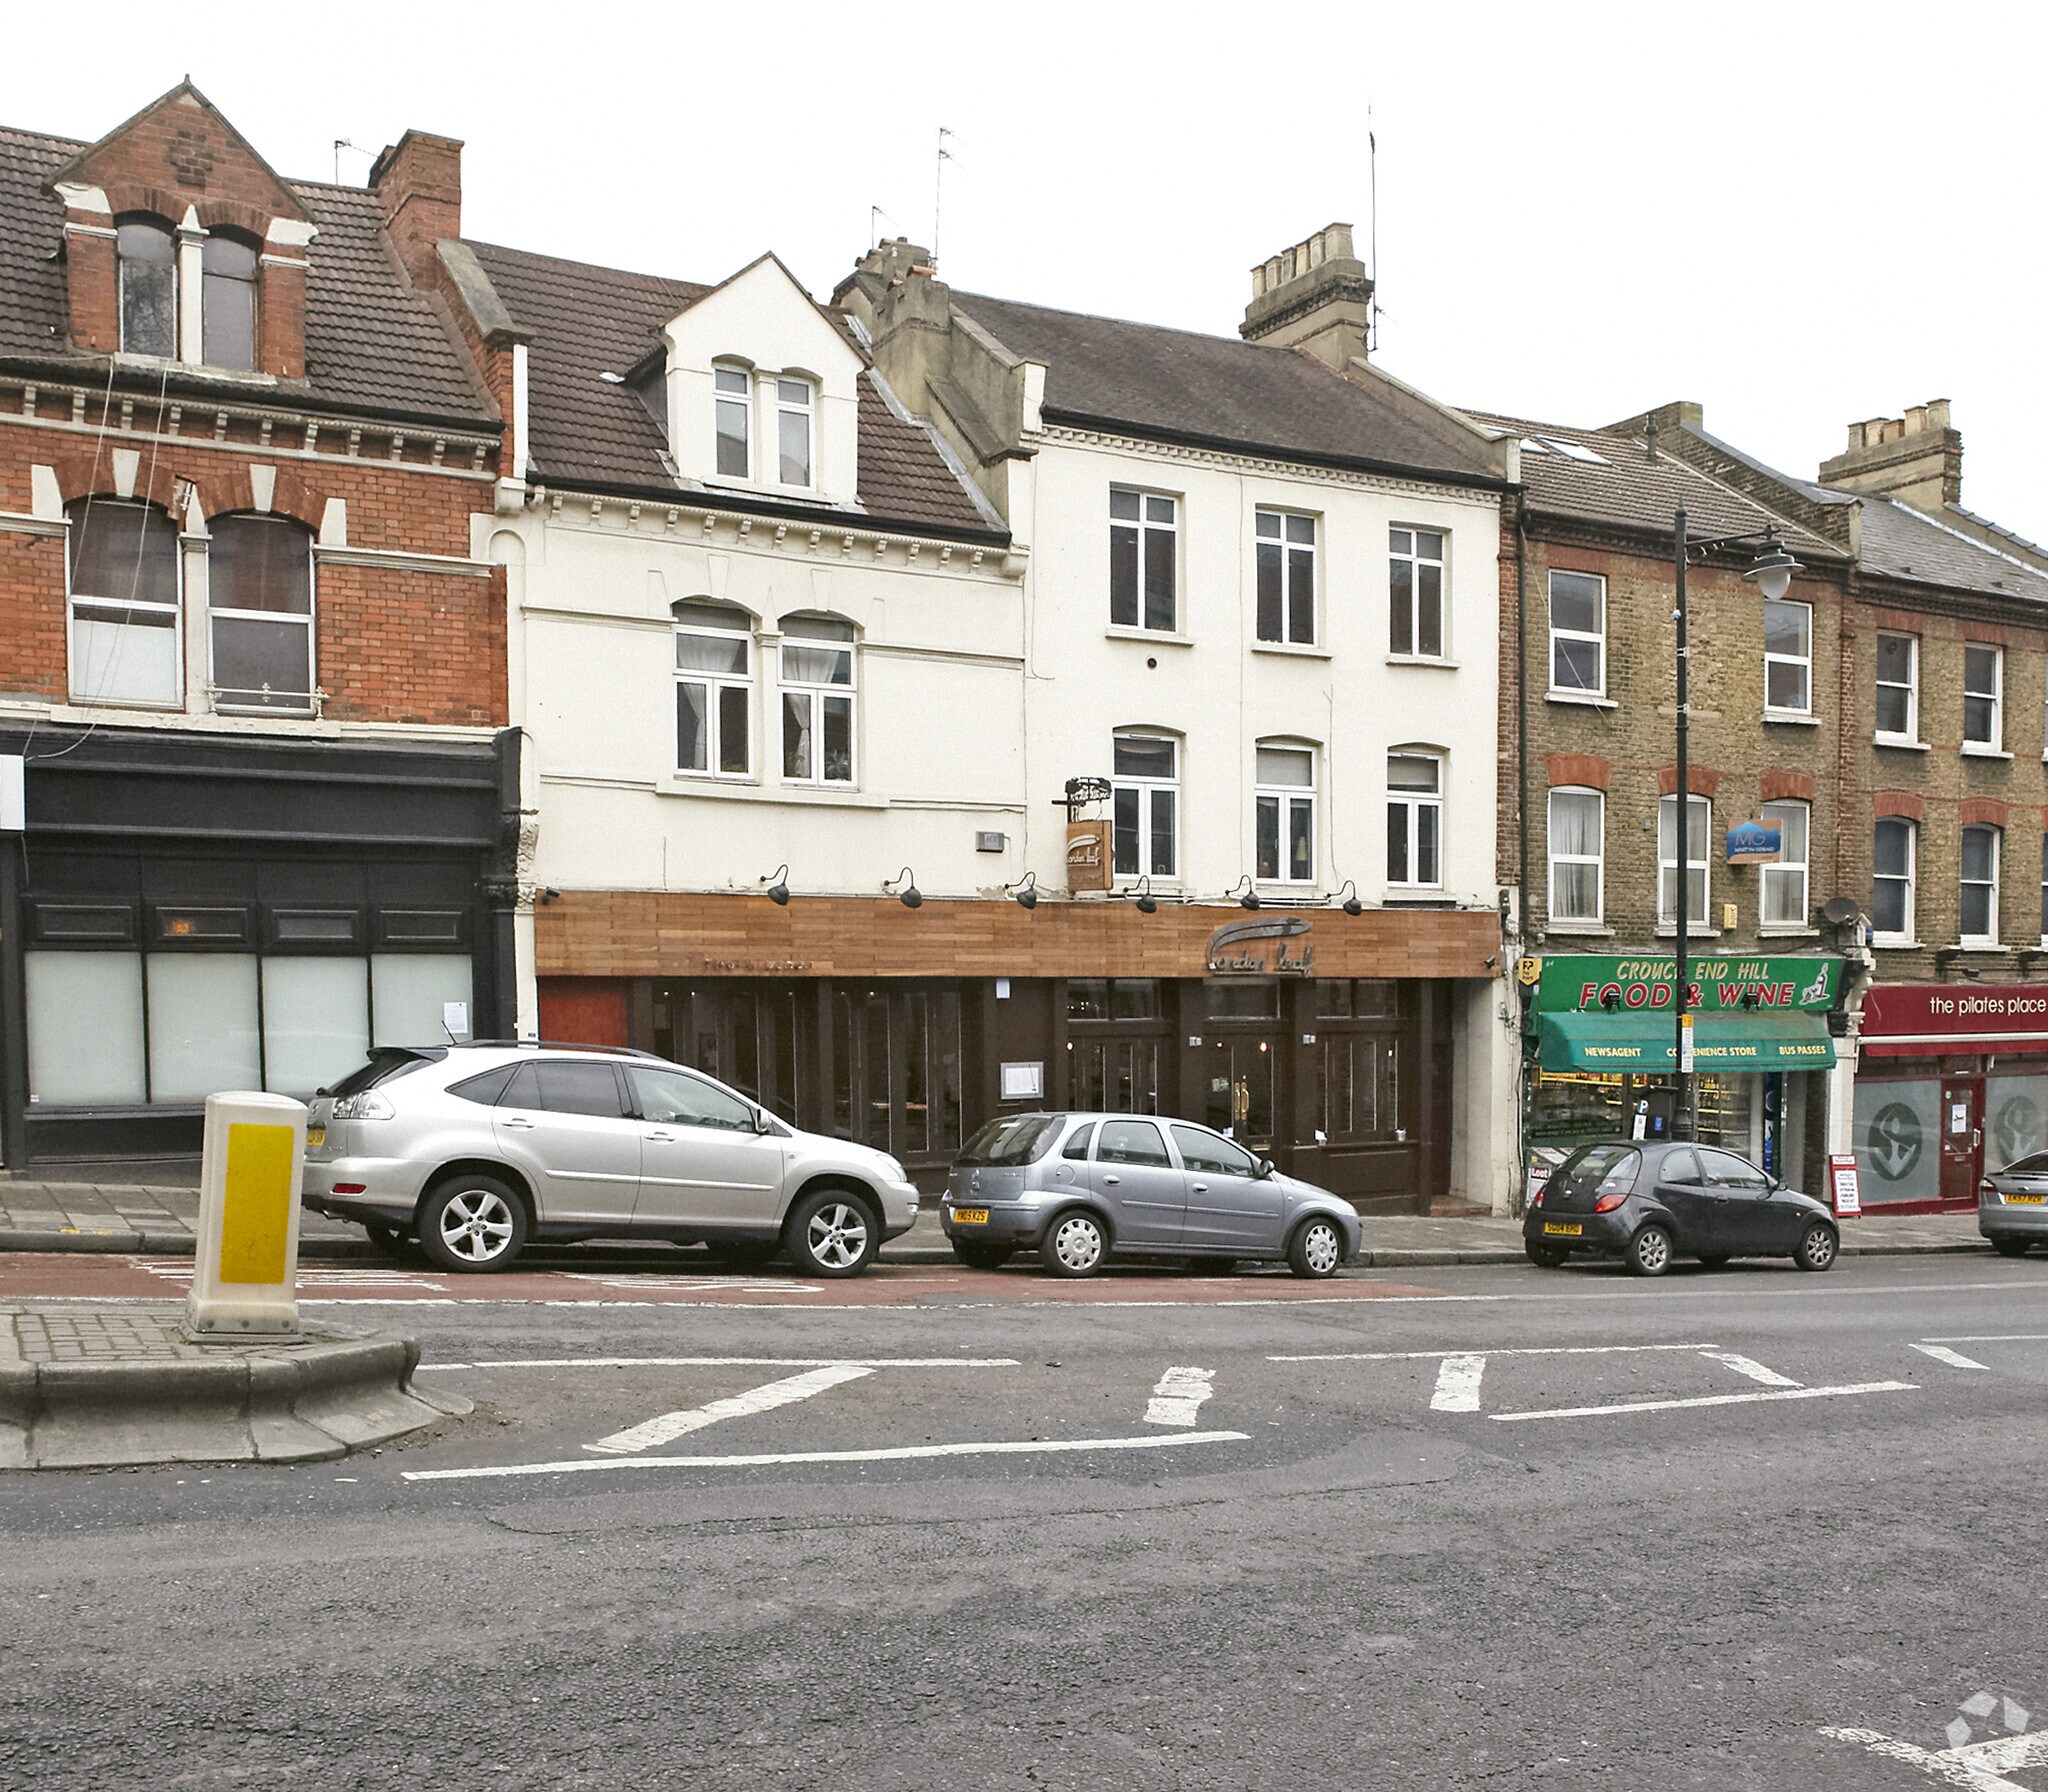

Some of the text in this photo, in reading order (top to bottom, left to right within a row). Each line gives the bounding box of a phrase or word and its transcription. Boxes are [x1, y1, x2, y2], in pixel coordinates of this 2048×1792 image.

[1735, 830, 1767, 846] MG
[1616, 960, 1769, 980] CROUC END HILL
[1579, 982, 1673, 1009] FOOD
[1686, 982, 1704, 1008] &
[1930, 996, 2047, 1017] the pilates place
[1584, 1046, 1641, 1058] NEWSAGENT
[1666, 1046, 1757, 1058] COENIENCE STORE
[1778, 1045, 1827, 1056] BUS PASSES
[1639, 1099, 1649, 1113] P
[1531, 1167, 1549, 1178] Loot
